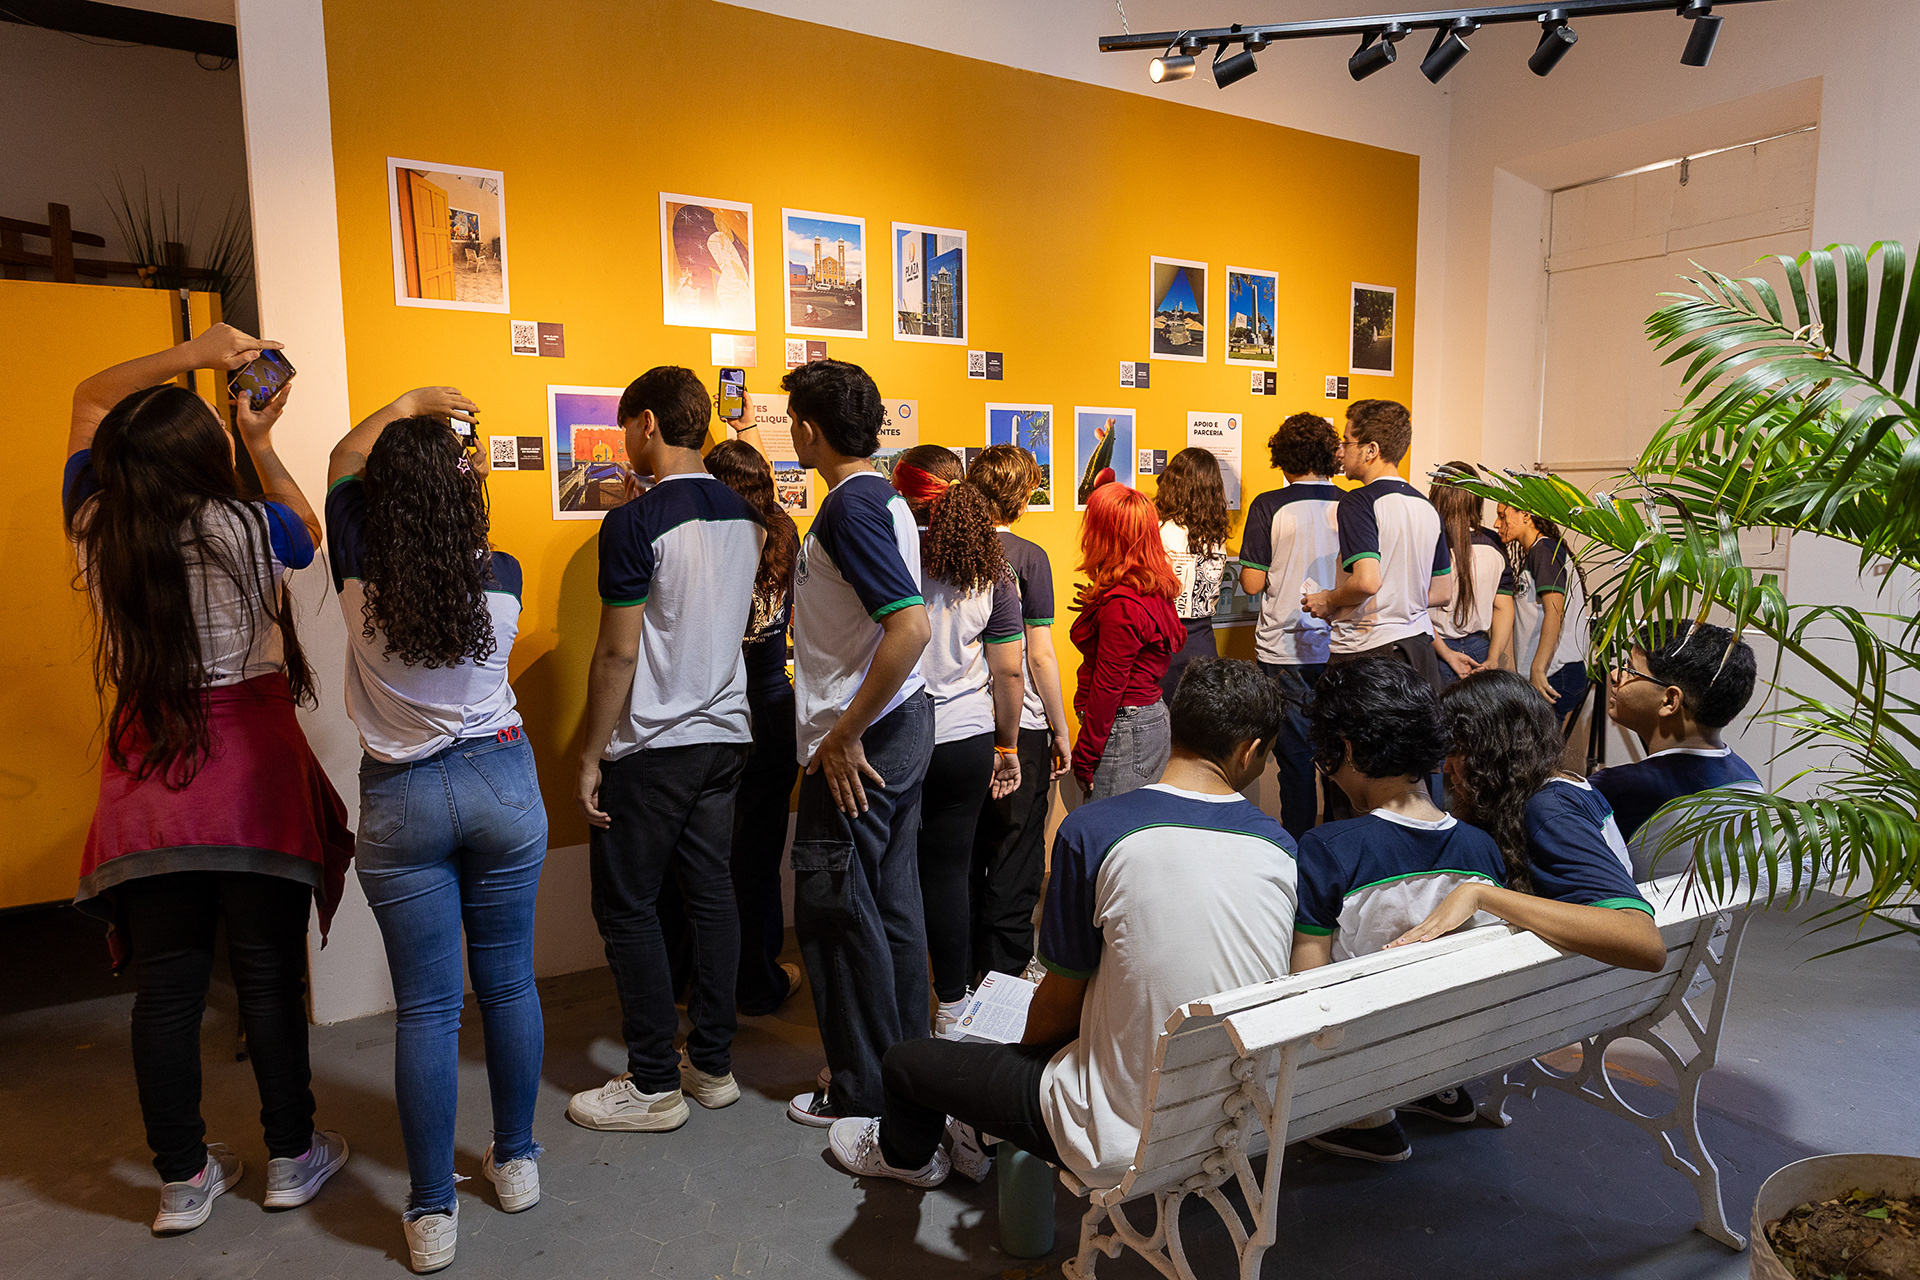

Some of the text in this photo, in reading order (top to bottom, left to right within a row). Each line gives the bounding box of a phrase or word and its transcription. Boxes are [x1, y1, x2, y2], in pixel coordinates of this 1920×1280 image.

[754, 415, 788, 425] CLIQUE
[878, 428, 901, 436] NTES
[1177, 592, 1188, 616] 2026
